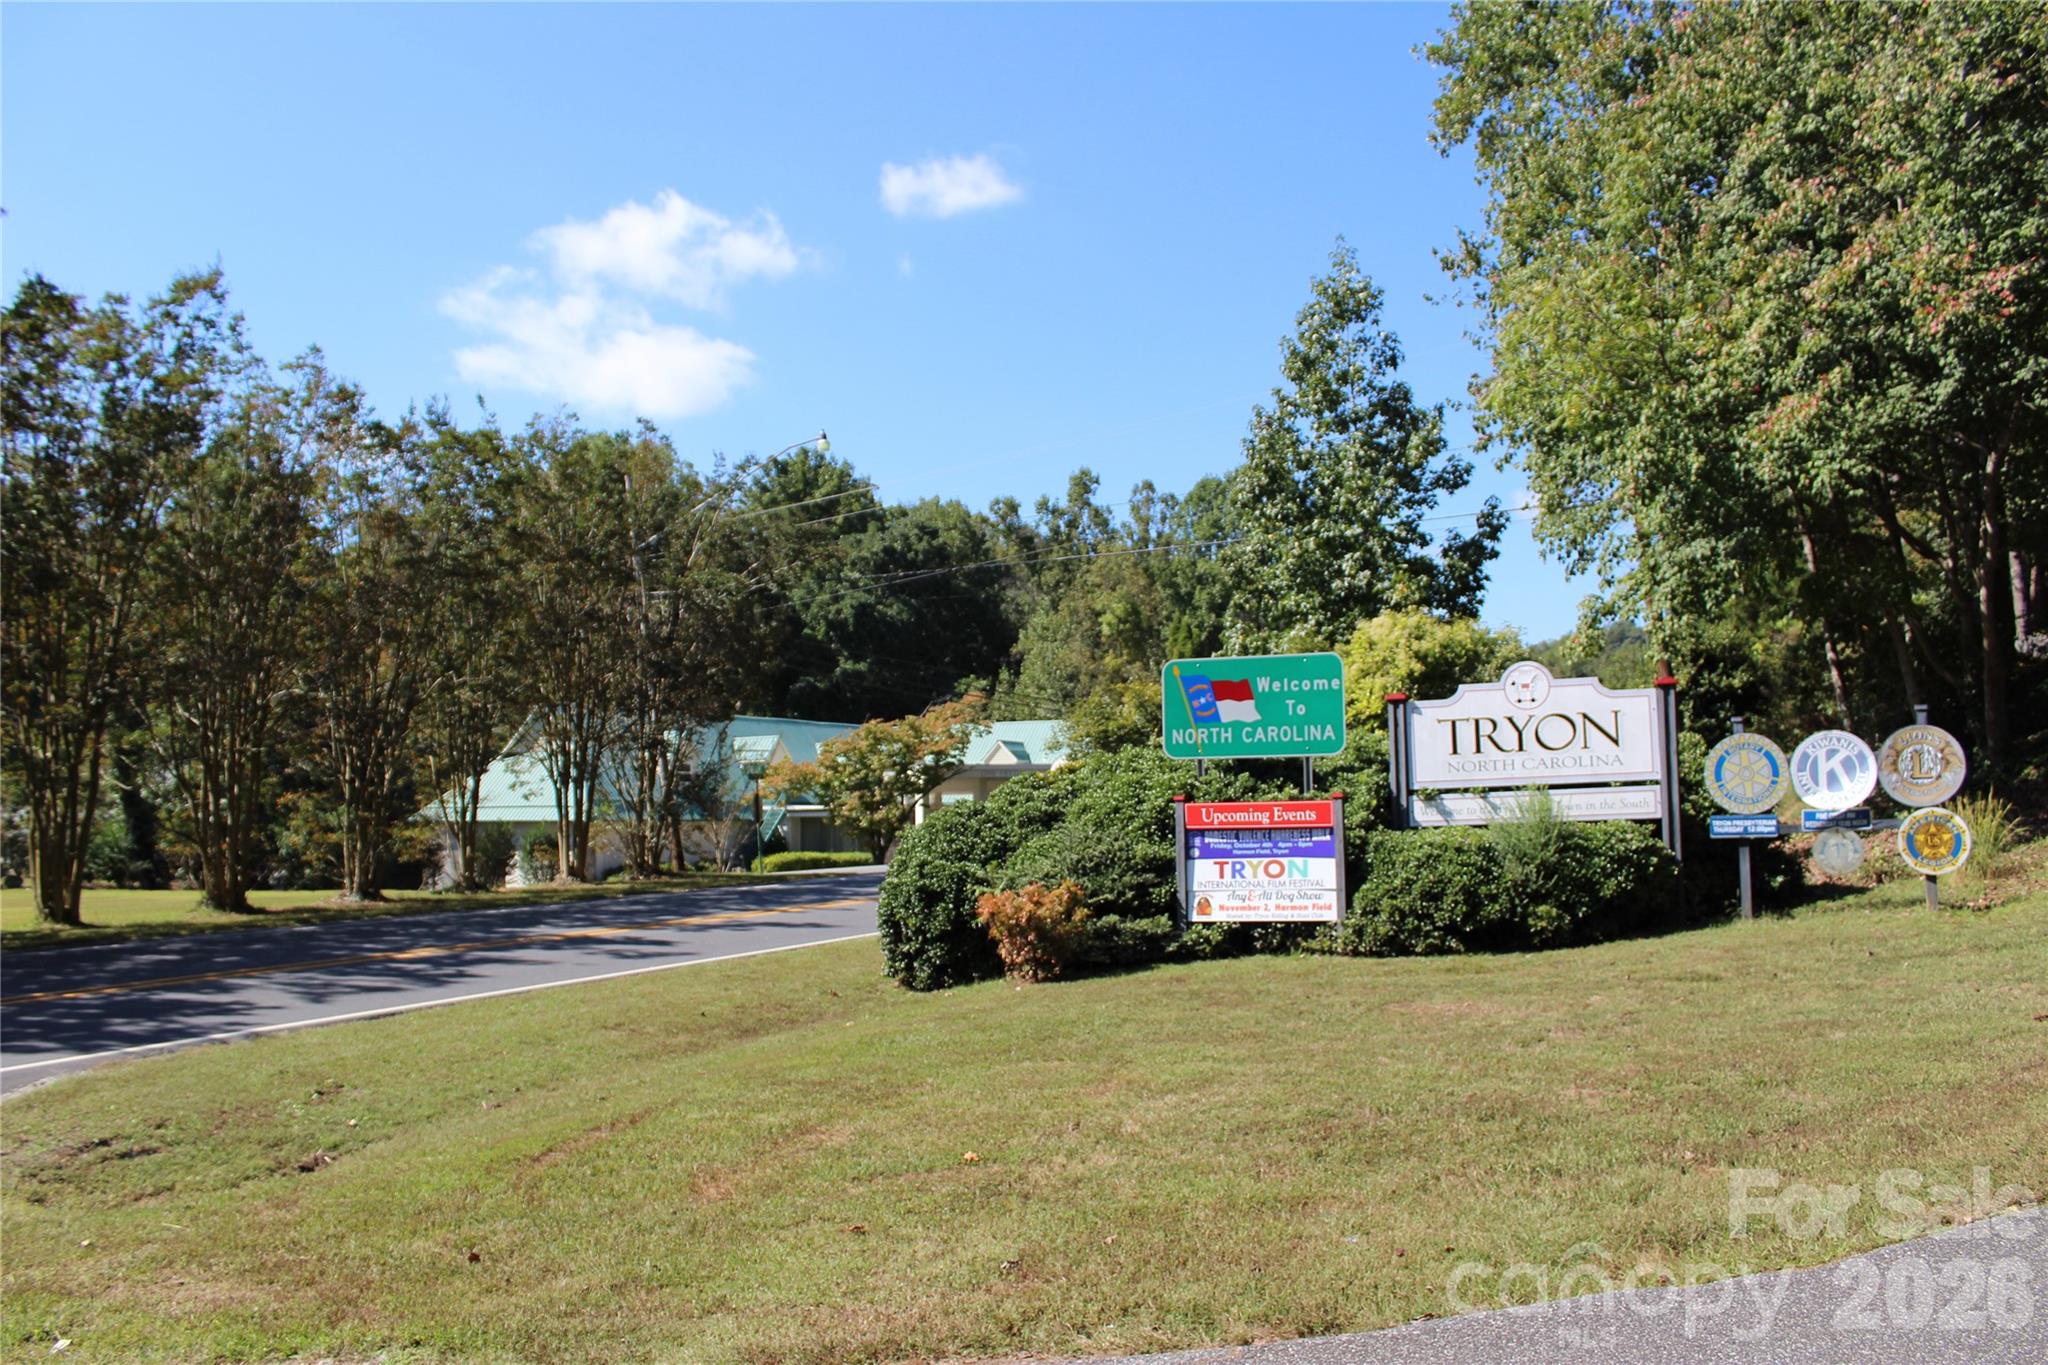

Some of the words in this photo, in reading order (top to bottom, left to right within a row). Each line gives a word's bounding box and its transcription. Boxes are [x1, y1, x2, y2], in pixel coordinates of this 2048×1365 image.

[1256, 676, 1341, 693] Welcome
[1285, 699, 1306, 716] To
[1172, 728, 1233, 744] NORTH
[1241, 725, 1336, 743] CAROLINA
[1436, 709, 1621, 755] TRYON
[1807, 736, 1859, 755] KIWANIS
[1448, 759, 1516, 774] NORTH
[1521, 754, 1624, 771] CAROLINA
[1817, 747, 1853, 793] K
[1421, 804, 1466, 817] Weme
[1586, 799, 1597, 811] in
[1600, 797, 1617, 810] the
[1619, 796, 1651, 810] South
[1201, 807, 1270, 824] Upcoming
[1273, 806, 1317, 821] Events
[1213, 859, 1309, 880] TRYON
[1197, 879, 1265, 889] INTERNATIONAL
[1267, 879, 1287, 888] FILM
[1289, 879, 1325, 888] FESTIVAL
[1227, 890, 1247, 902] Any
[1275, 890, 1294, 902] Dog
[1296, 889, 1324, 901] Show
[1219, 904, 1261, 912] November
[1275, 903, 1309, 911] Harmon
[1312, 903, 1332, 911] Field
